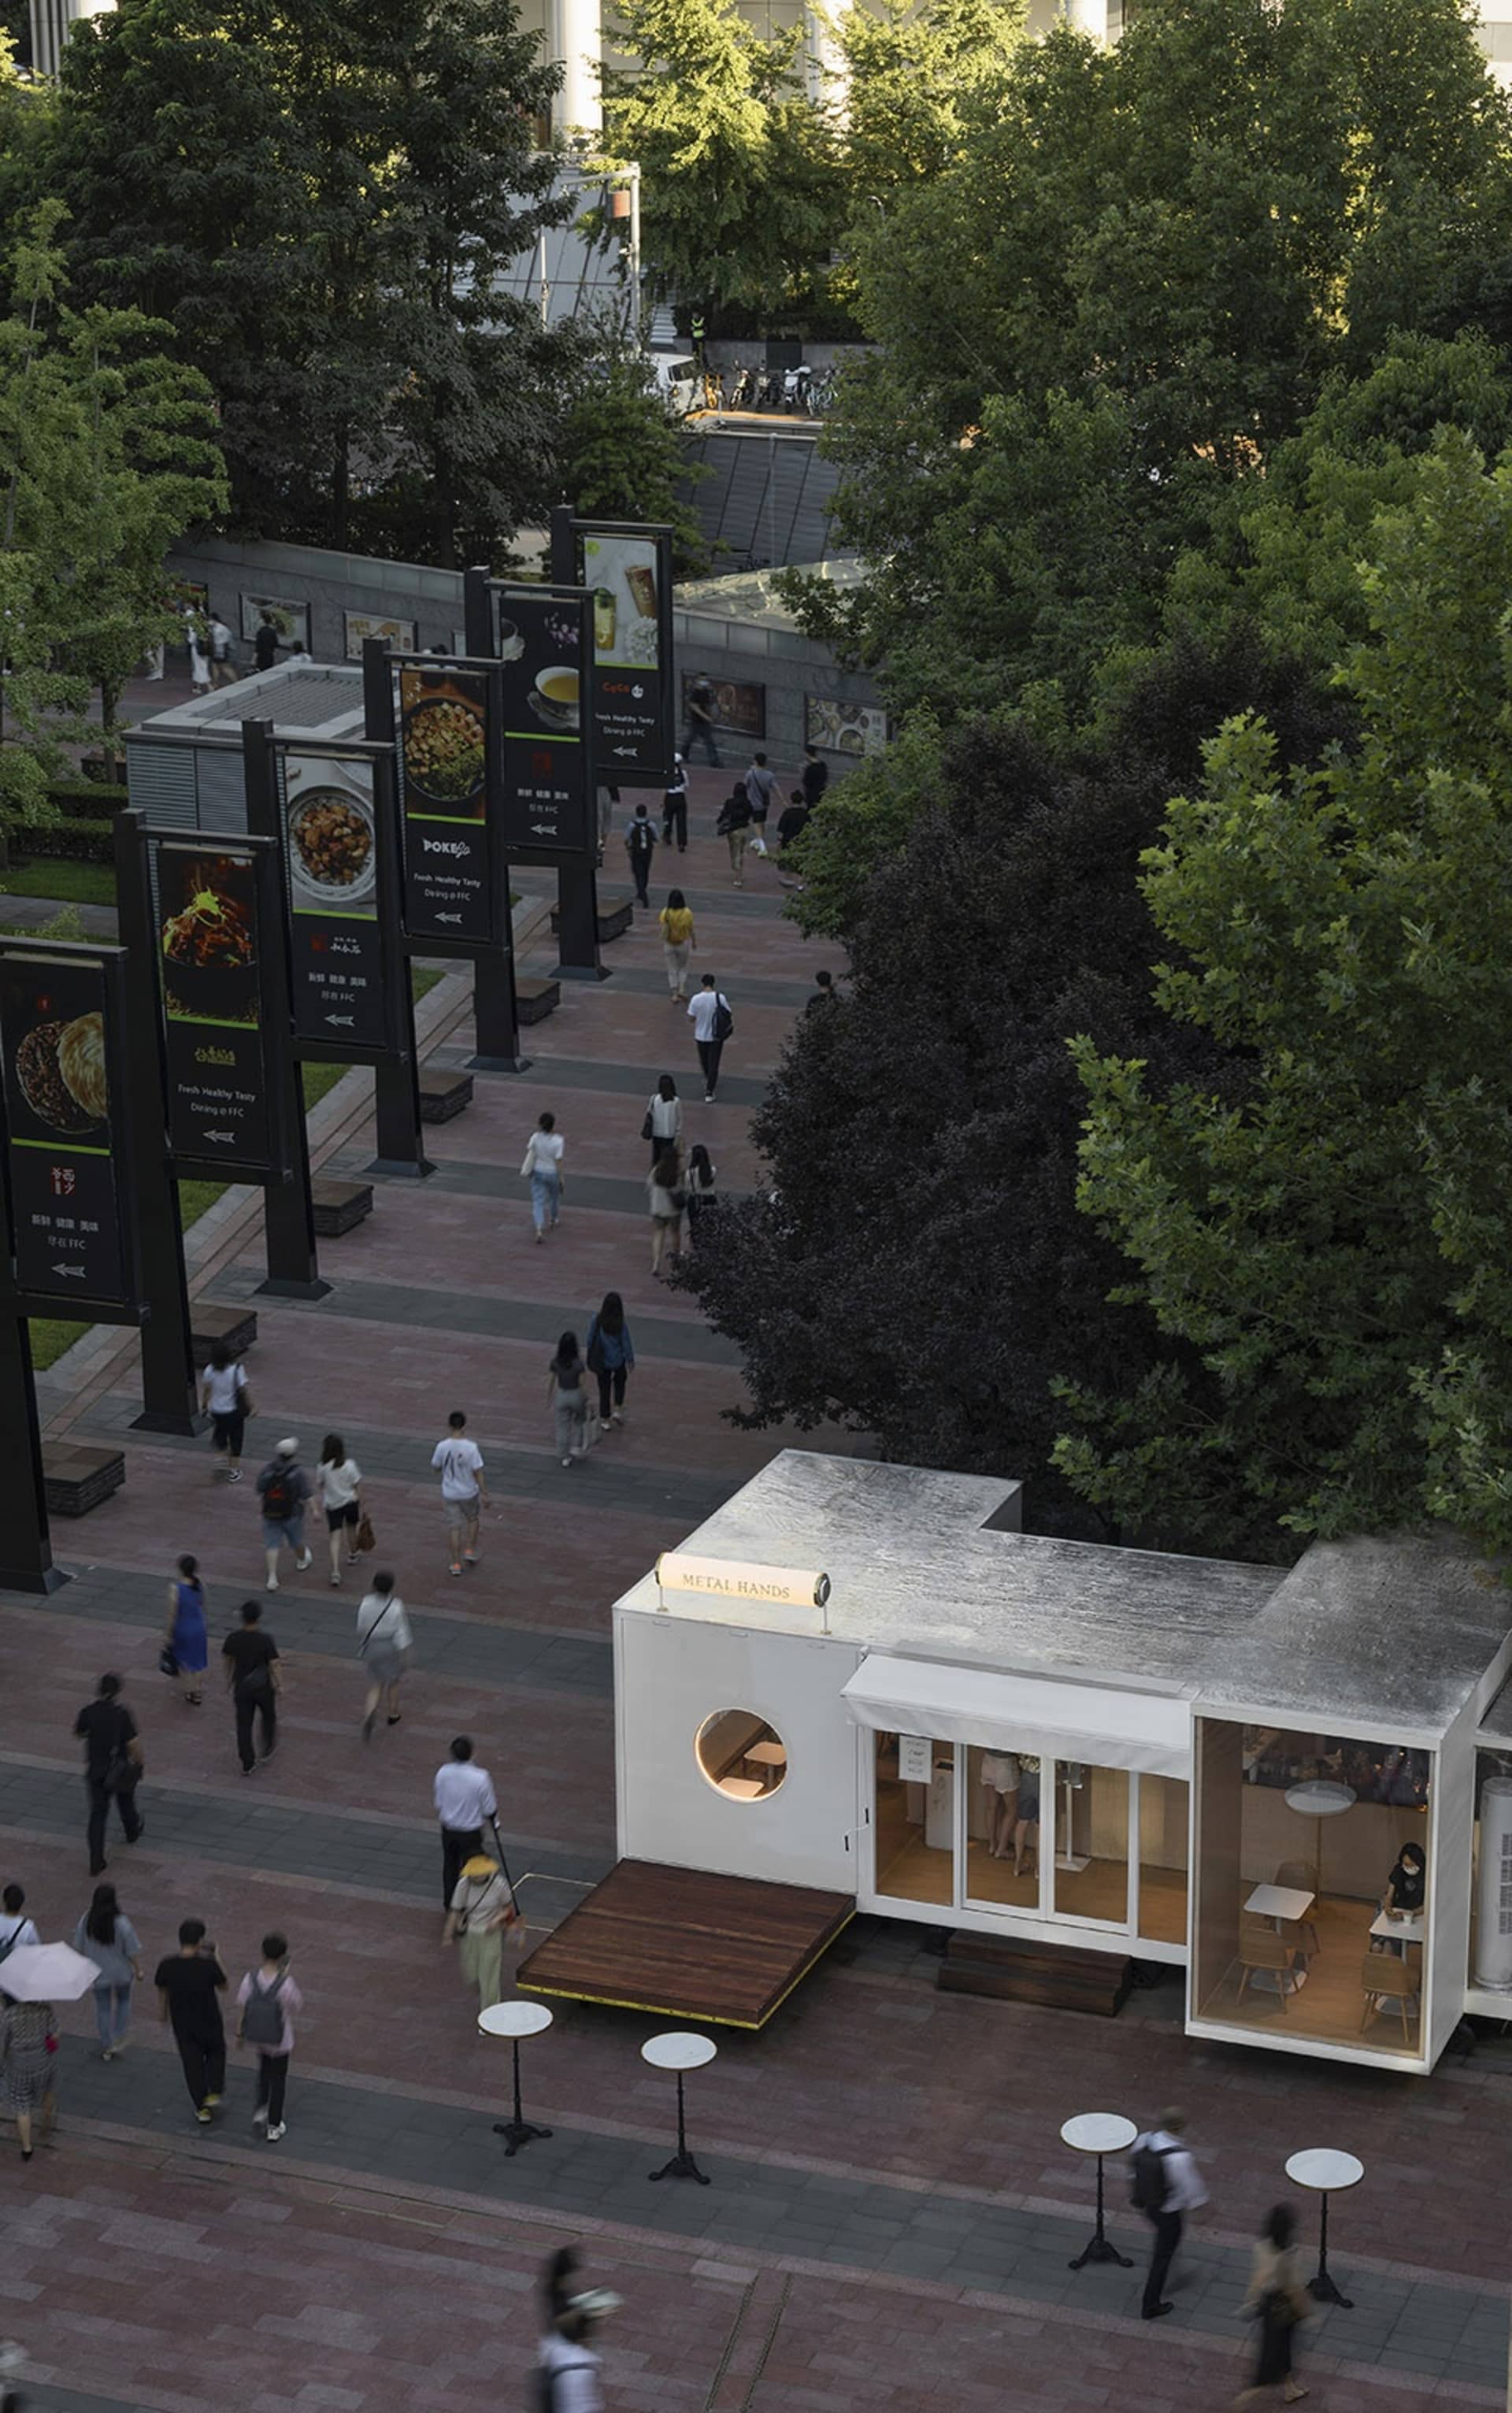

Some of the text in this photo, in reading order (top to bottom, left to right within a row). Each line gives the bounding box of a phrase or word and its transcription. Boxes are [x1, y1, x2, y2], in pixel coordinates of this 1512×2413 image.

[613, 714, 637, 724] Healthy
[413, 873, 481, 889] Fresh Healthy Tasty
[424, 888, 449, 900] Dining
[177, 1084, 257, 1103] Fresh Healthy Tasty
[191, 1103, 218, 1116] Dining
[228, 1106, 245, 1118] FFC
[69, 1239, 86, 1250] FFC
[683, 1574, 791, 1599] METAL HANDS
